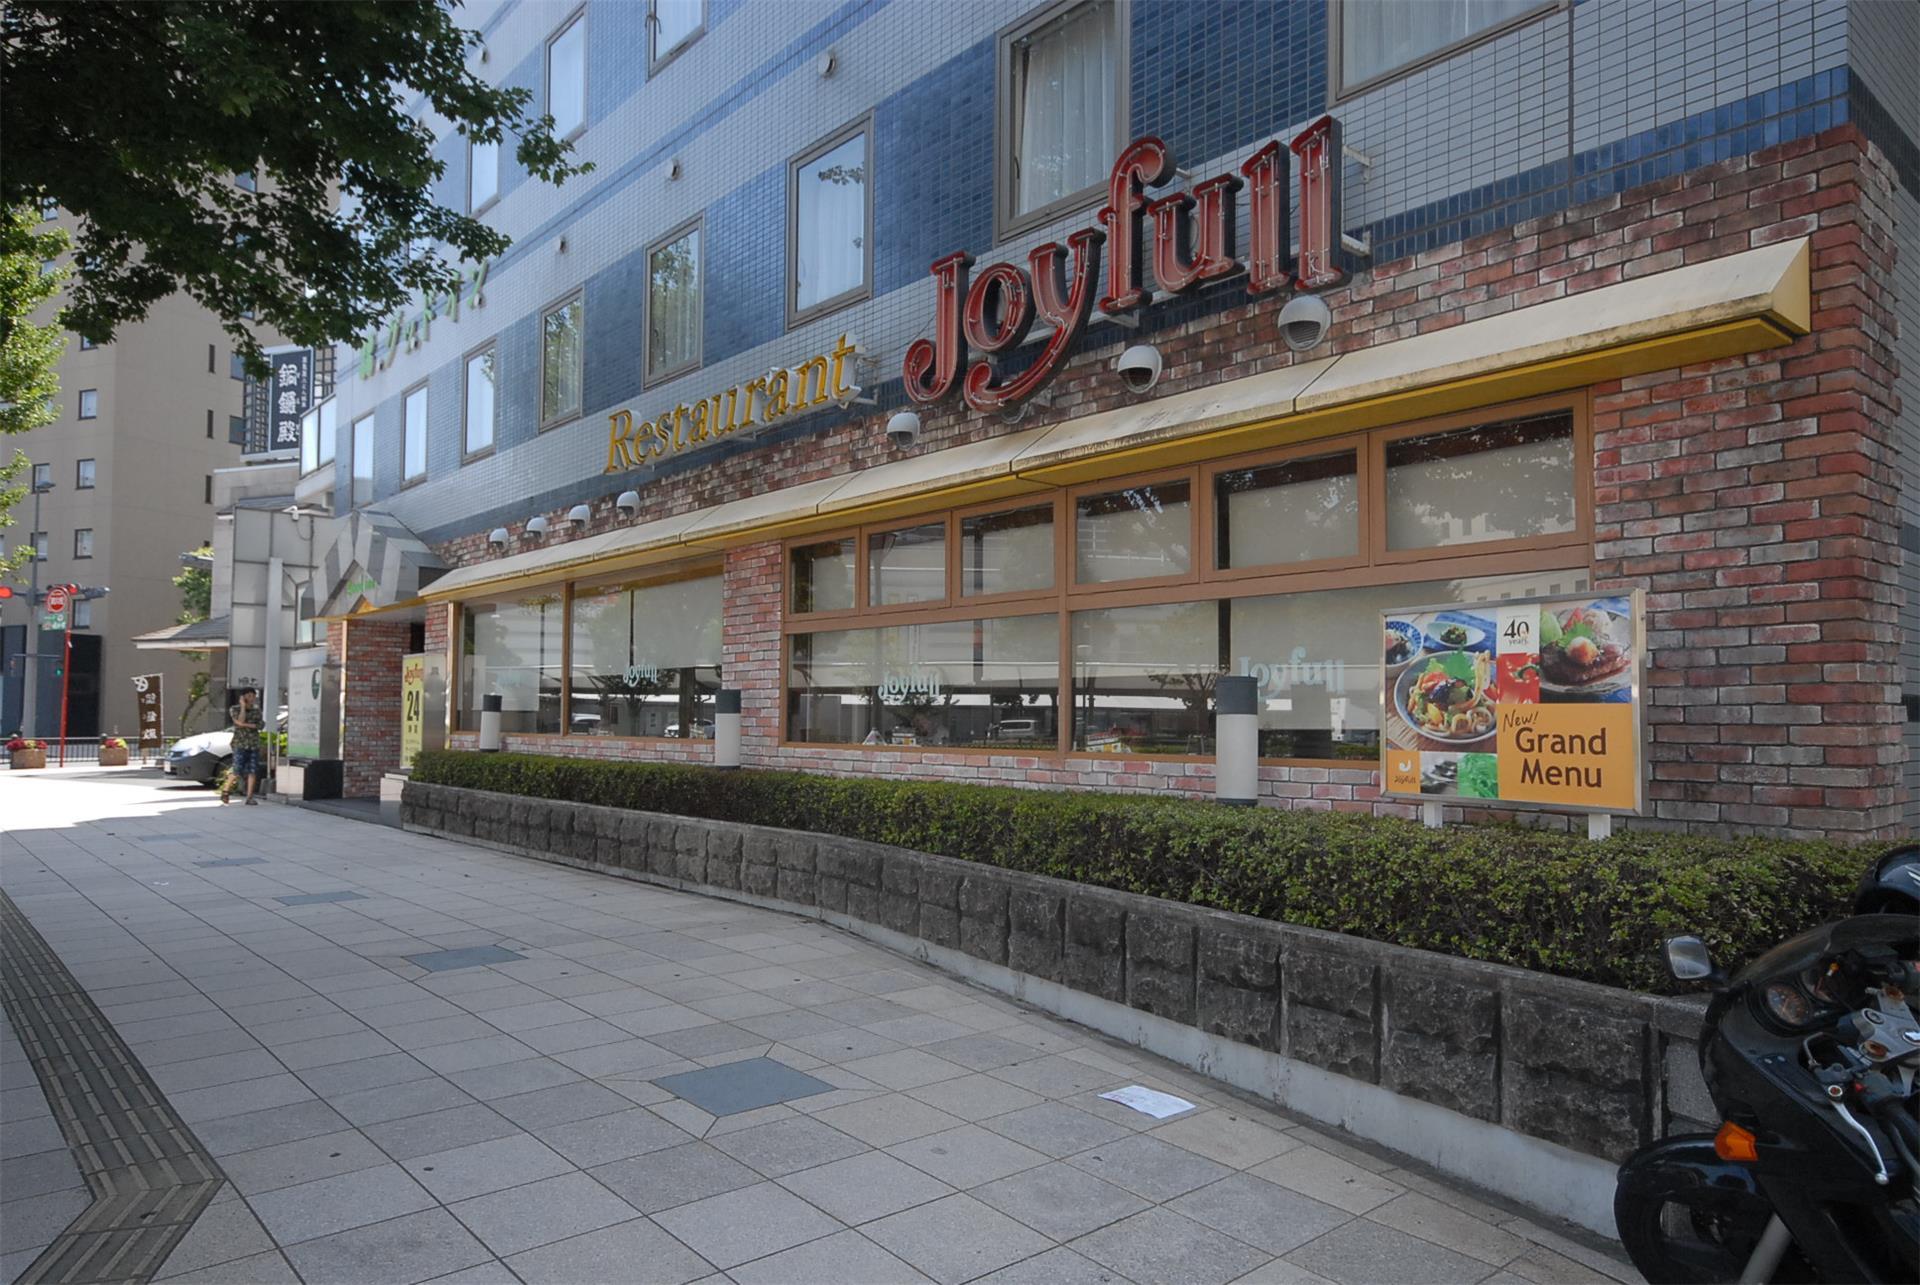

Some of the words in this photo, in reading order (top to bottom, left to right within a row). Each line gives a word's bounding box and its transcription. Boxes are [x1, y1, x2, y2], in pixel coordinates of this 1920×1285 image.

[903, 115, 1353, 415] Joyfull
[604, 332, 859, 475] Restaurant
[1503, 618, 1530, 638] 40
[878, 665, 943, 703] Joyfull
[406, 690, 420, 721] 24
[1502, 710, 1539, 733] New!
[1515, 727, 1607, 756] Grand
[1520, 758, 1602, 788] Menu
